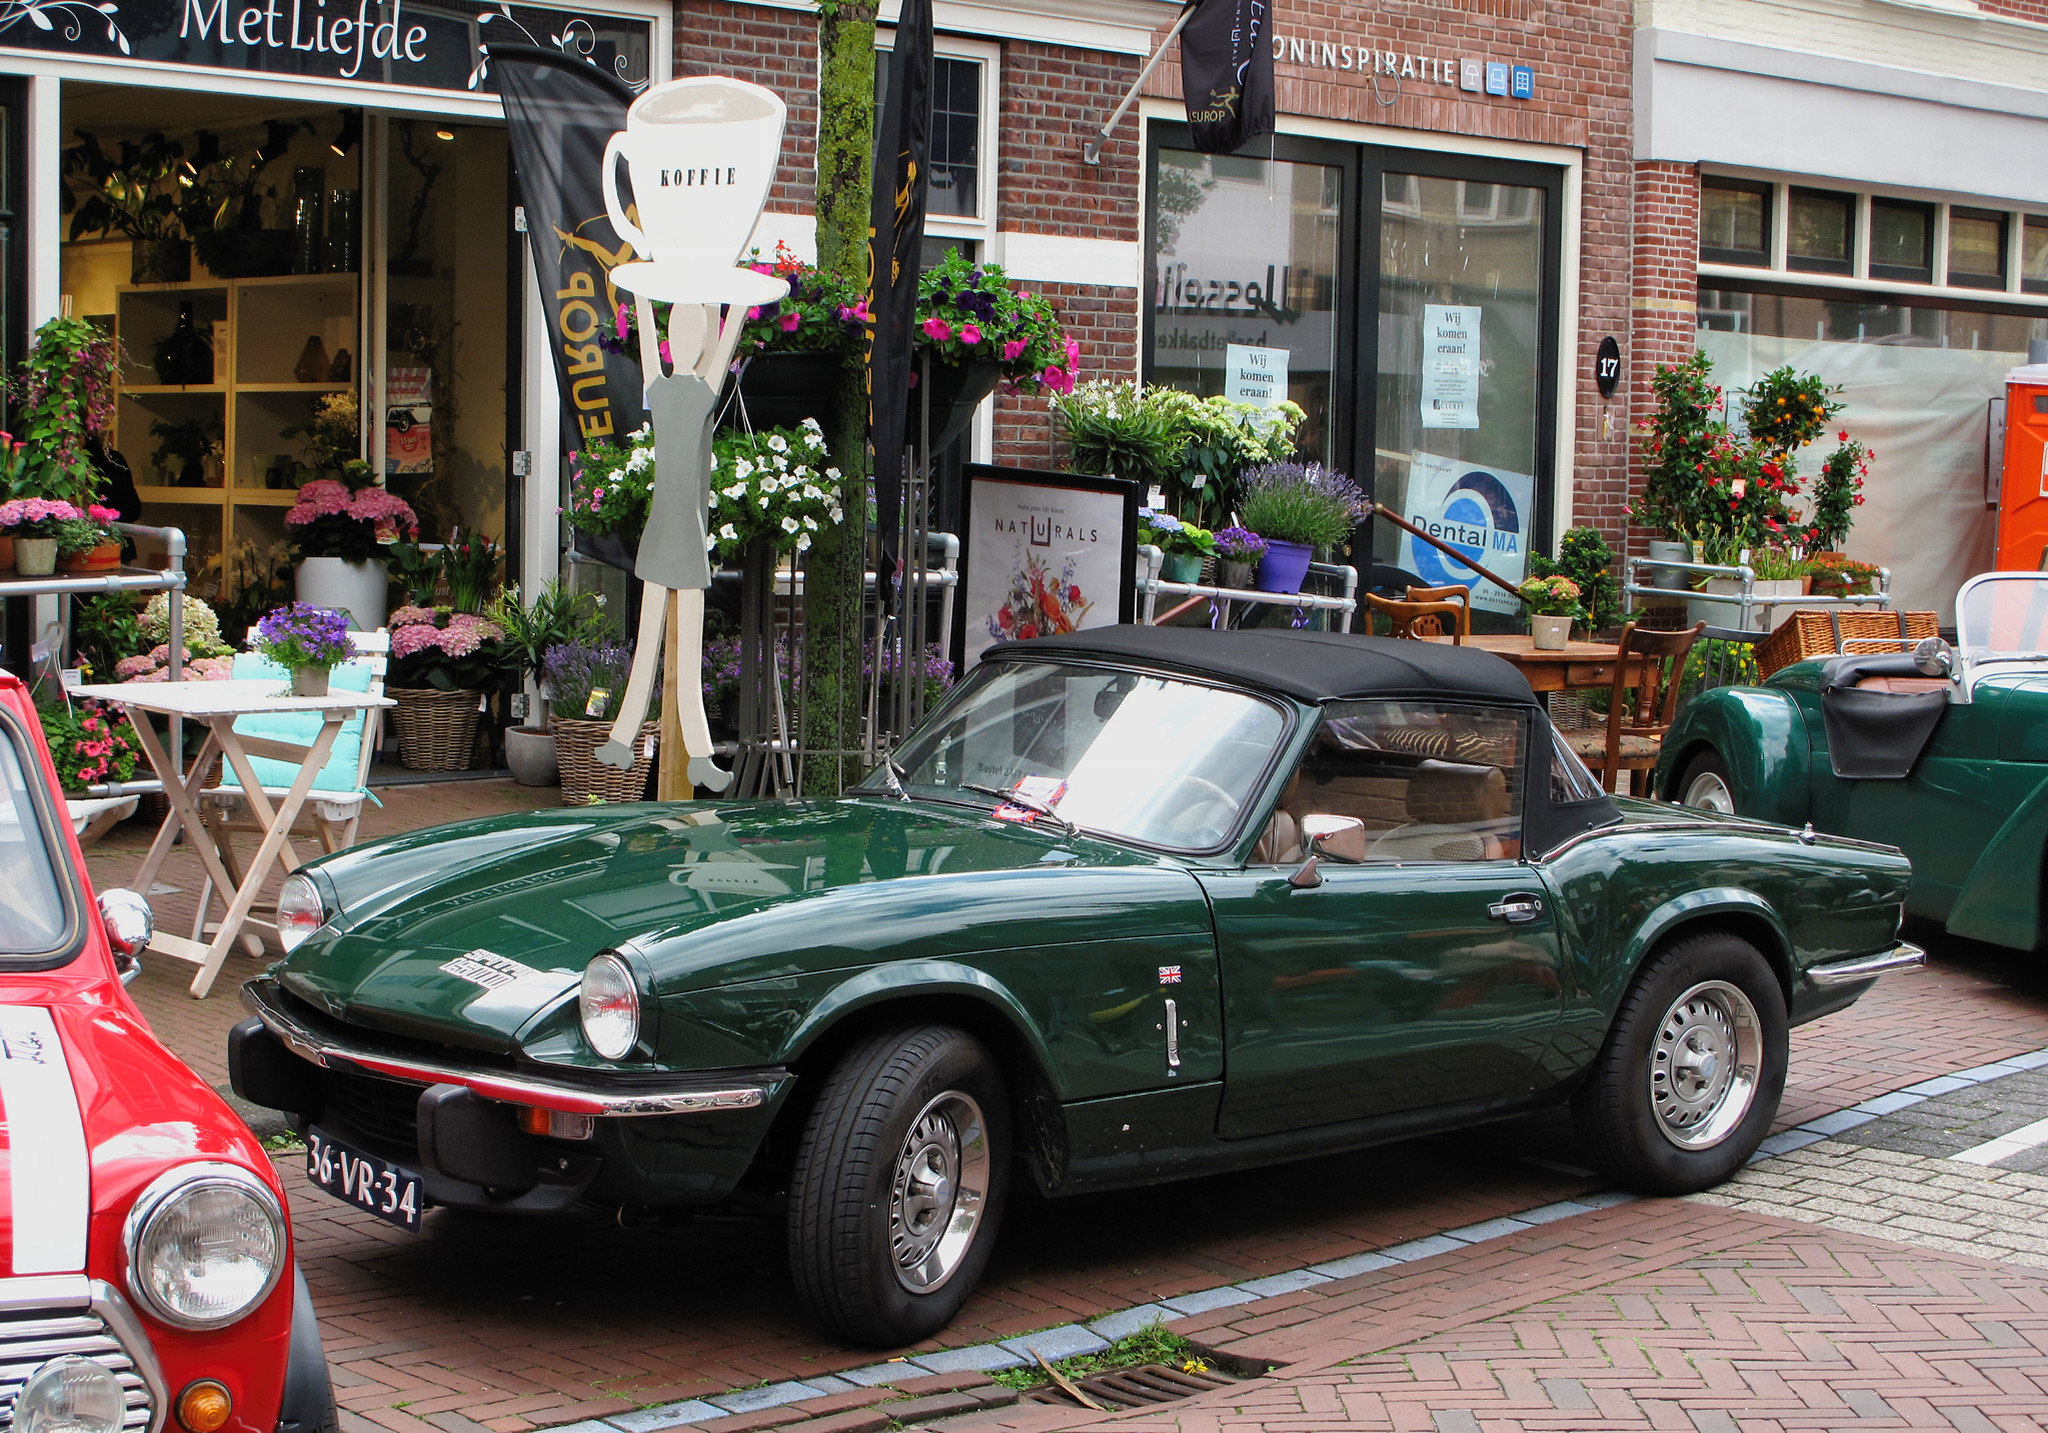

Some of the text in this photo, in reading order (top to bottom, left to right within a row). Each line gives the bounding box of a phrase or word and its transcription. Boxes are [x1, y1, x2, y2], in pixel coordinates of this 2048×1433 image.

[660, 167, 736, 187] KOFFIE
[1445, 312, 1461, 326] Wij
[1436, 327, 1467, 339] komen
[1437, 344, 1466, 354] eraan!
[1249, 354, 1268, 368] Wij
[1600, 357, 1618, 378] 17
[1239, 368, 1274, 383] komen
[1239, 387, 1272, 399] eraan!
[994, 515, 1098, 547] NATURALS
[1412, 514, 1518, 553] Dental MA
[308, 1133, 417, 1224] 36-VR-34
